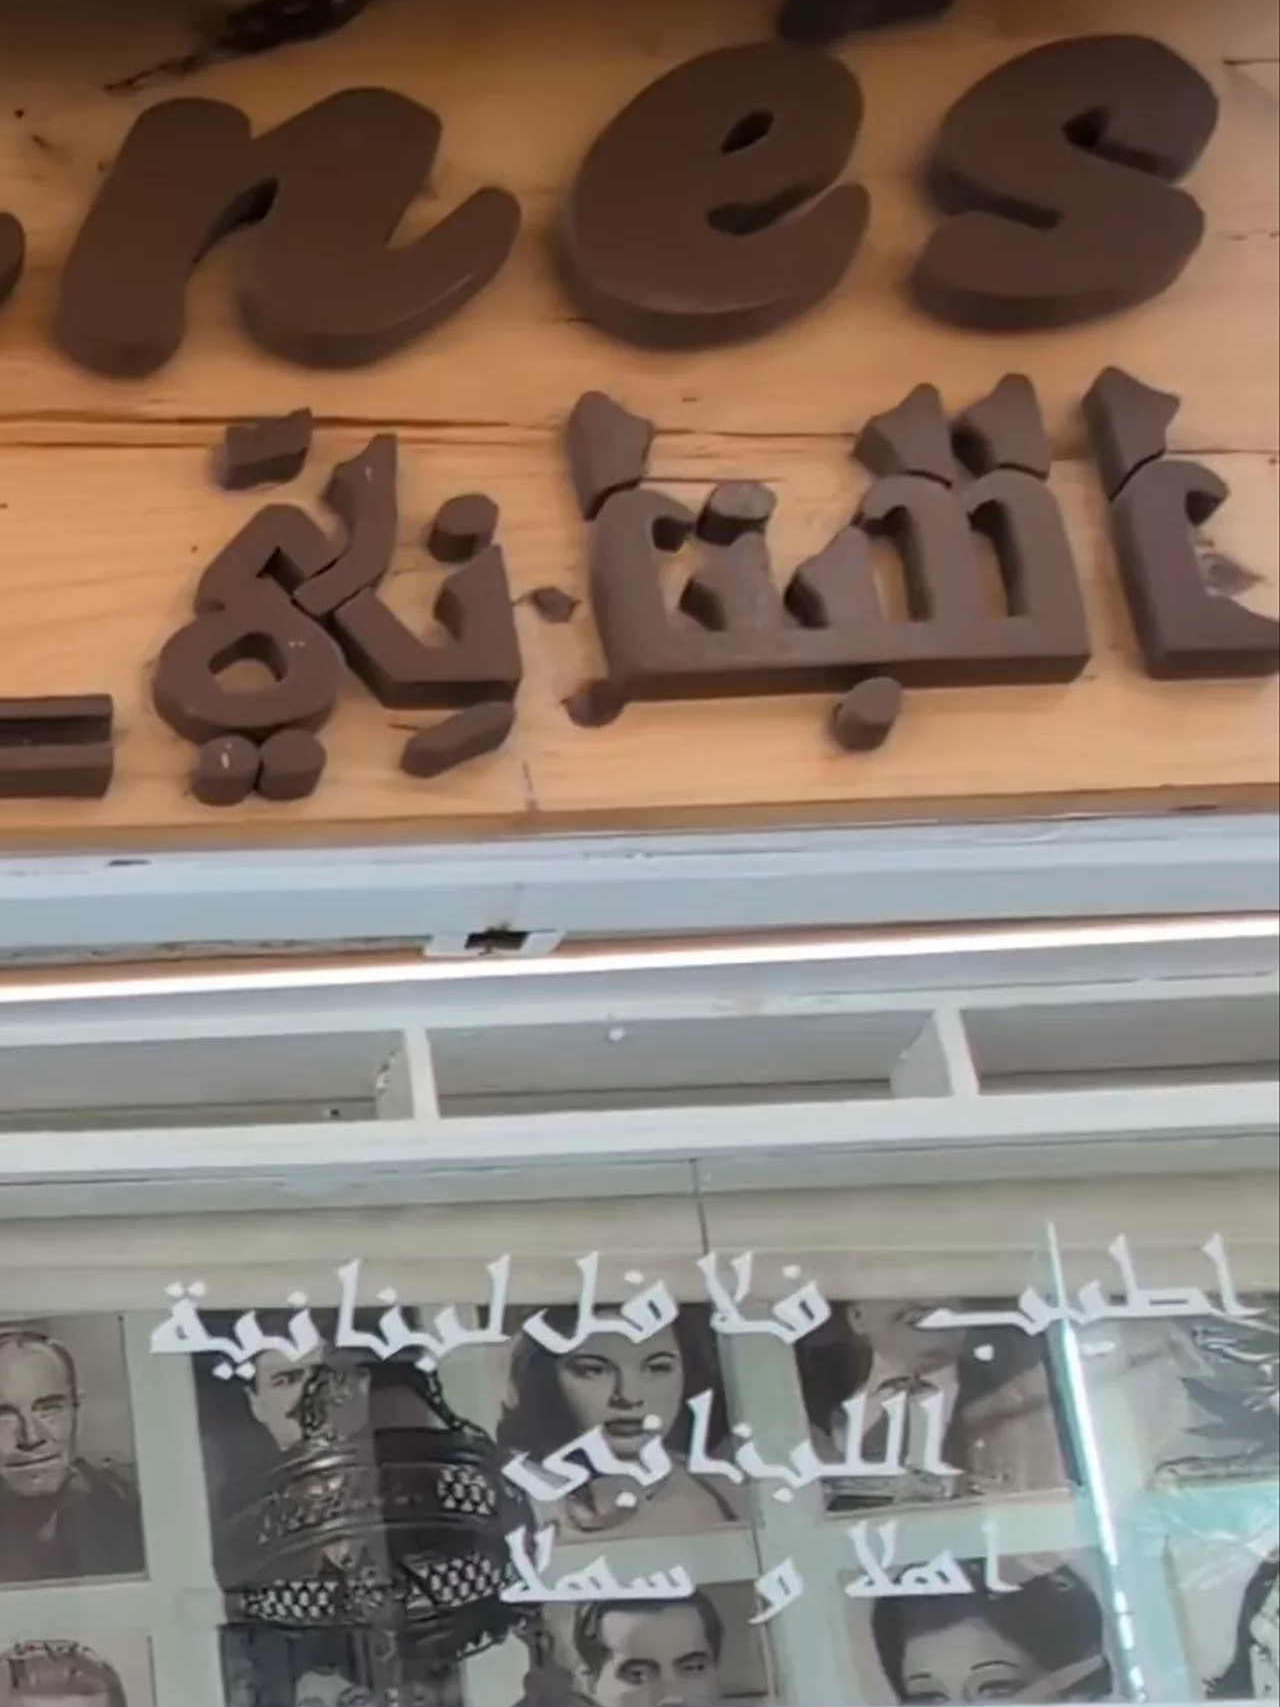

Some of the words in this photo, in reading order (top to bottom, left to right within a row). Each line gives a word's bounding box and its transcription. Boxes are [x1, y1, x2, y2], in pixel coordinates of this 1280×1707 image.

[150, 1251, 512, 1382] لبنانية
[500, 1525, 700, 1603] سهلا
[749, 1555, 804, 1625] و
